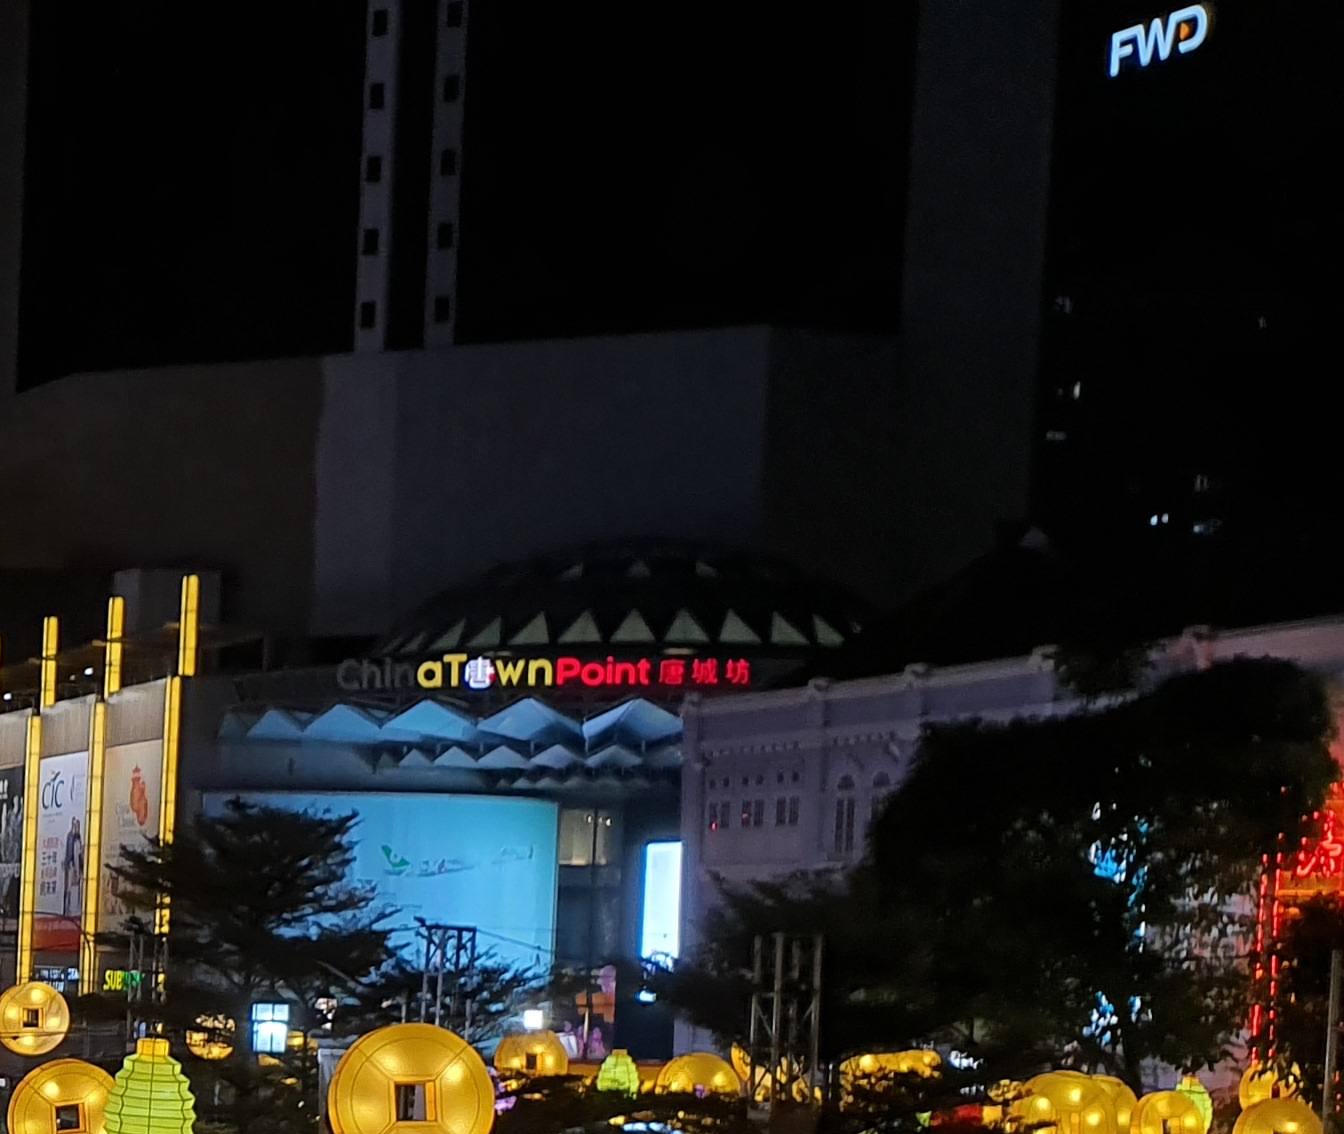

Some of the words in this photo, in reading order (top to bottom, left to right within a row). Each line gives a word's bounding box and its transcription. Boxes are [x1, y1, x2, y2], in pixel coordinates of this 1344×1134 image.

[1110, 4, 1208, 77] FWD
[658, 658, 750, 686] 唐城坊
